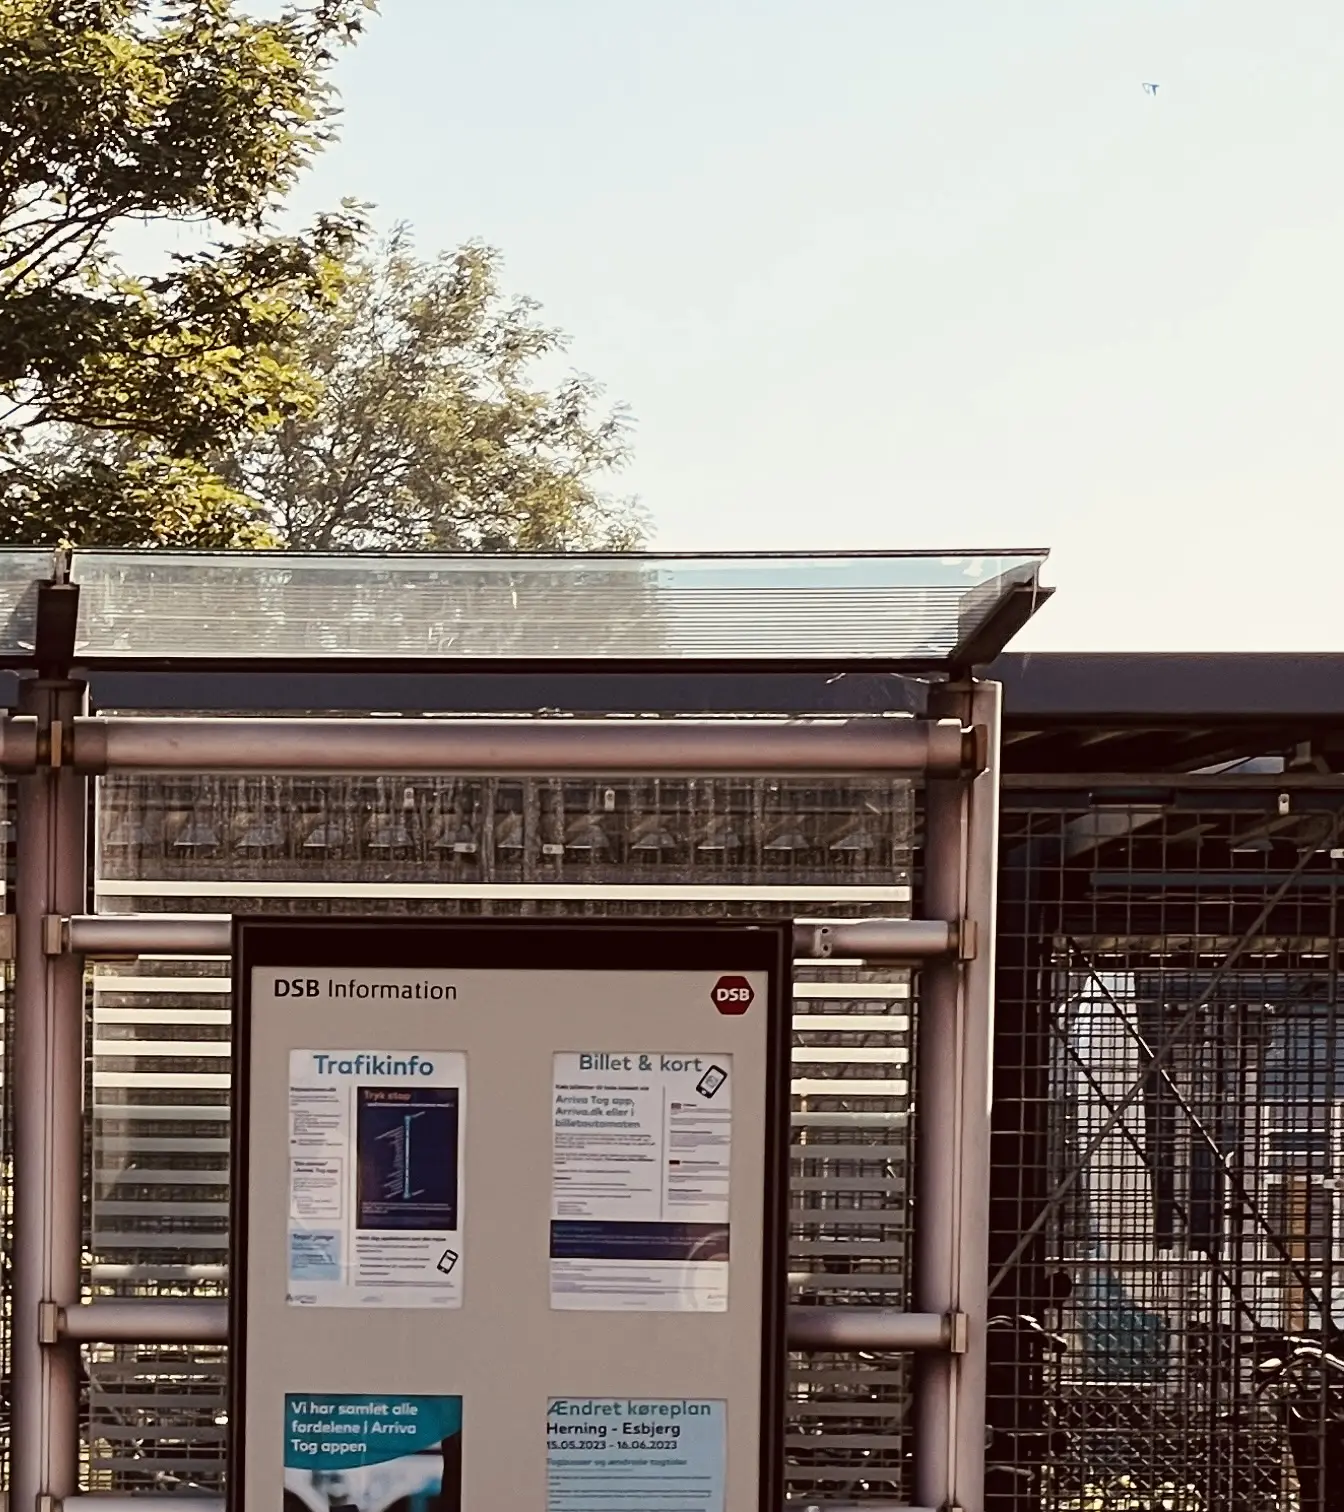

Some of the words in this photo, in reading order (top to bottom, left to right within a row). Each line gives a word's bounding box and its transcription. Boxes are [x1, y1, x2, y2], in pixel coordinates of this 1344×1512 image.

[274, 979, 320, 998] DSB
[328, 979, 457, 1000] Information
[717, 988, 750, 1001] DSB
[313, 1055, 434, 1076] Trafikinfo
[579, 1054, 632, 1072] Billet
[638, 1055, 652, 1071] &
[660, 1054, 703, 1072] kort
[591, 1095, 610, 1107] Tog
[291, 1401, 306, 1415] Vi
[310, 1402, 334, 1415] har
[338, 1402, 390, 1416] samlet
[392, 1402, 419, 1416] alle
[547, 1400, 622, 1416] Ændret
[627, 1400, 711, 1419] køreplan
[291, 1420, 360, 1434] fordelene
[363, 1421, 368, 1434] i
[371, 1421, 417, 1434] Arriva
[546, 1422, 607, 1437] Herning
[622, 1422, 681, 1438] Esbjerg
[290, 1438, 318, 1454] Tog
[320, 1441, 367, 1455] appen
[546, 1440, 607, 1450] 15.05.2023
